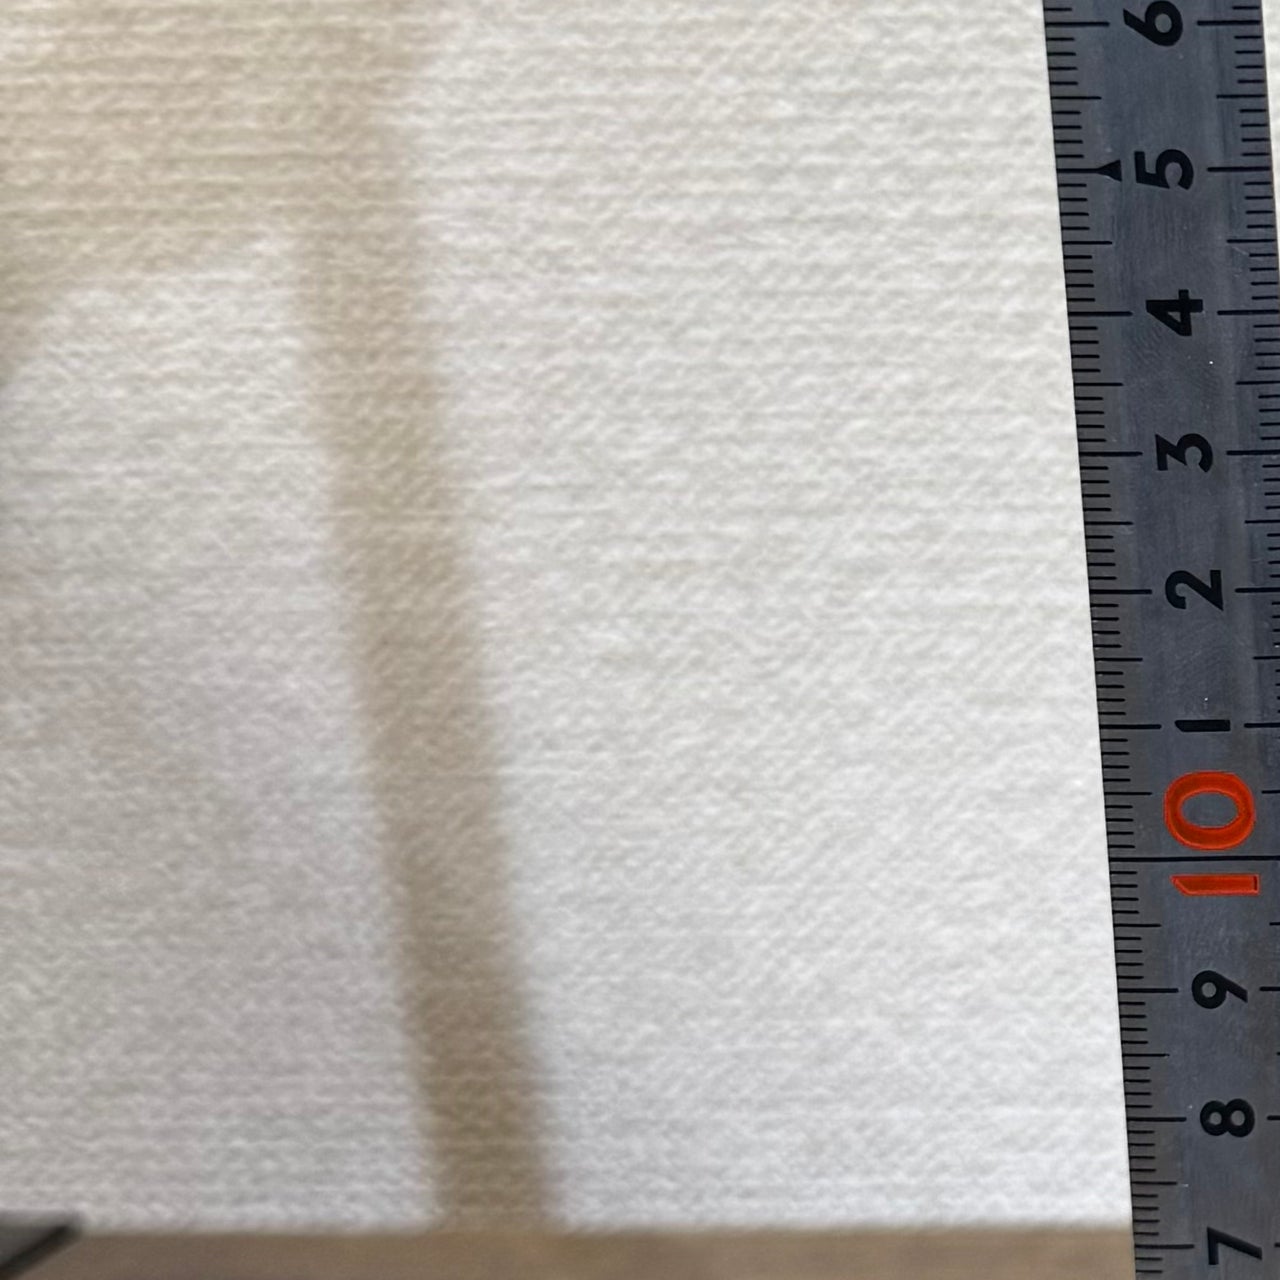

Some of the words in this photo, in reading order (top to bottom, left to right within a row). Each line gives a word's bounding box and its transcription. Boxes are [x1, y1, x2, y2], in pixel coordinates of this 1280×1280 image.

[1123, 0, 1183, 46] 6
[1134, 149, 1193, 189] 5
[1146, 290, 1203, 336] 4
[1155, 434, 1213, 472] 3
[1165, 570, 1223, 611] 2
[1175, 720, 1230, 732] 1
[1164, 771, 1259, 896] 10
[1192, 971, 1247, 1009] 9
[1200, 1099, 1254, 1137] 8
[1207, 1227, 1262, 1265] 7
